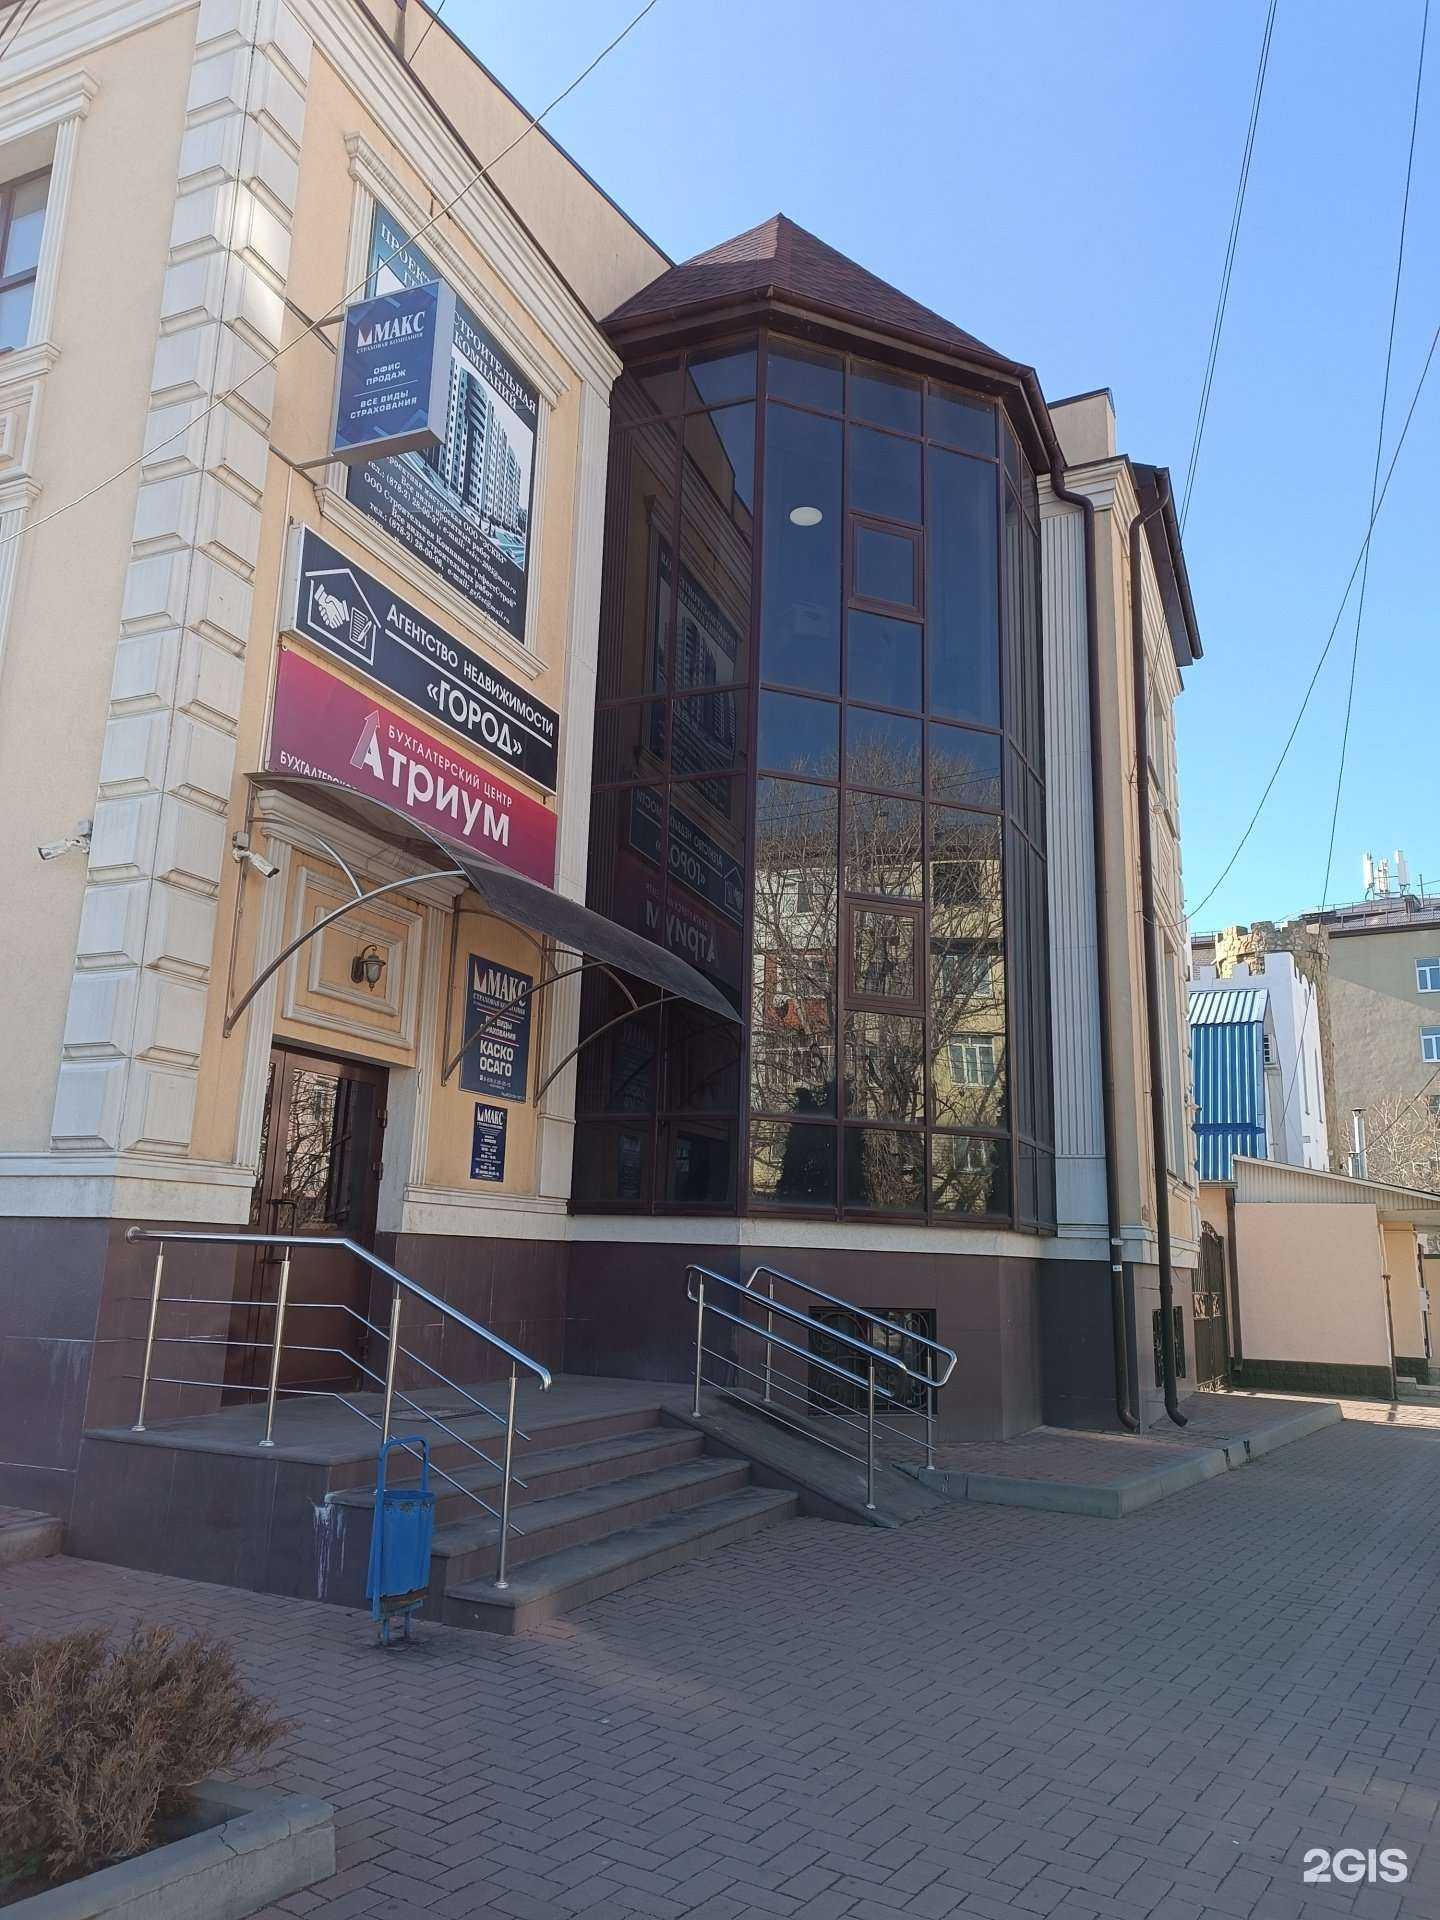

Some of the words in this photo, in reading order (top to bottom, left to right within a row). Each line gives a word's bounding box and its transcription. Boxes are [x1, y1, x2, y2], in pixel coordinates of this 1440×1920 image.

[374, 311, 425, 344] МАКС
[356, 340, 388, 354] СТРАХОВАЯ
[390, 332, 423, 347] КОМПАНИЯ
[366, 368, 406, 386] ПРОДАЖ
[373, 361, 401, 375] ОФИС
[350, 397, 417, 419] СТРАХОВАНИЯ
[360, 397, 378, 408] ВСЕ
[380, 389, 409, 403] ВИДЫ
[364, 472, 382, 493] ООО
[386, 603, 458, 668] АГЕНТСТВО
[463, 660, 553, 737] НЕДВИЖИМОСТИ
[426, 679, 522, 755] «ГОРОД»
[388, 724, 480, 790] БУХГАЛТЕРСКИЙ
[483, 782, 512, 808] ЦЕНТР
[487, 968, 527, 1007] МАКС
[480, 1040, 514, 1062] КАСКО
[480, 1056, 512, 1077] ОСАГО
